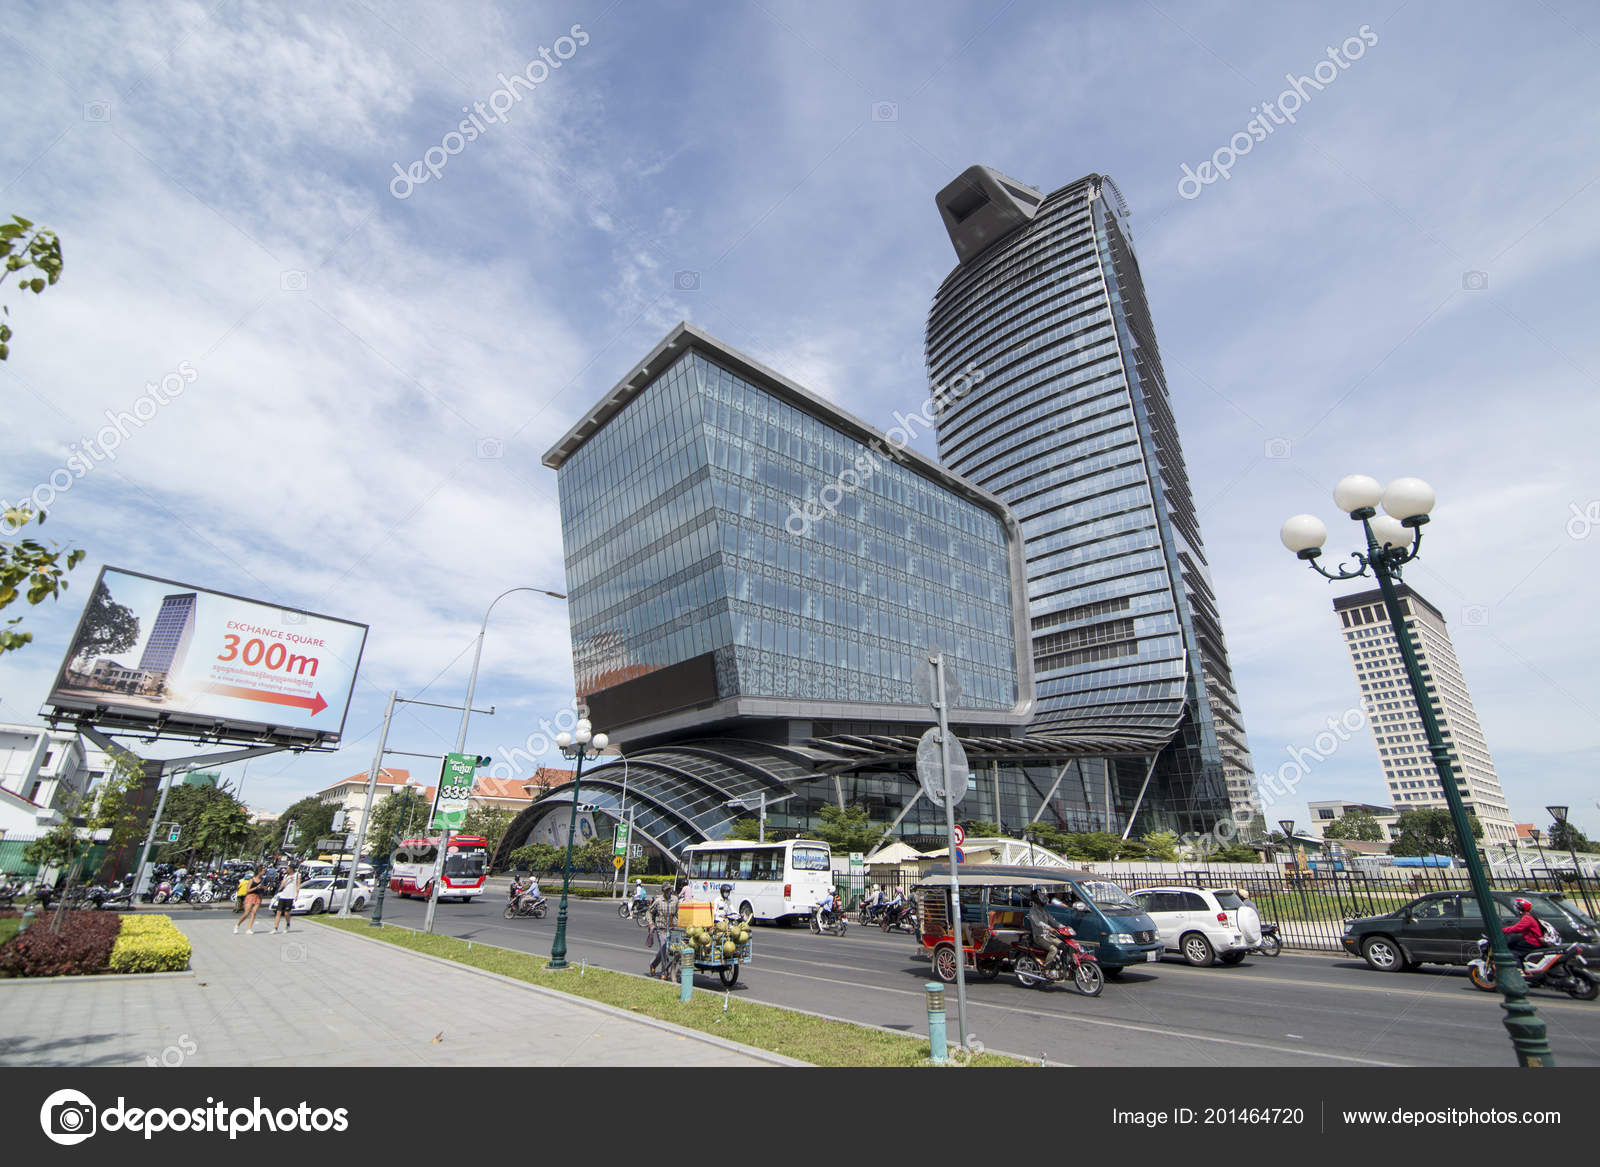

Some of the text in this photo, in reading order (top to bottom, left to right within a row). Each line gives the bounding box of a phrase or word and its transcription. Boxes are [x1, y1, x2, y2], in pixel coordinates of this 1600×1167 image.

[226, 620, 326, 648] EXCHANGE SQUARE
[217, 633, 319, 677] 300m
